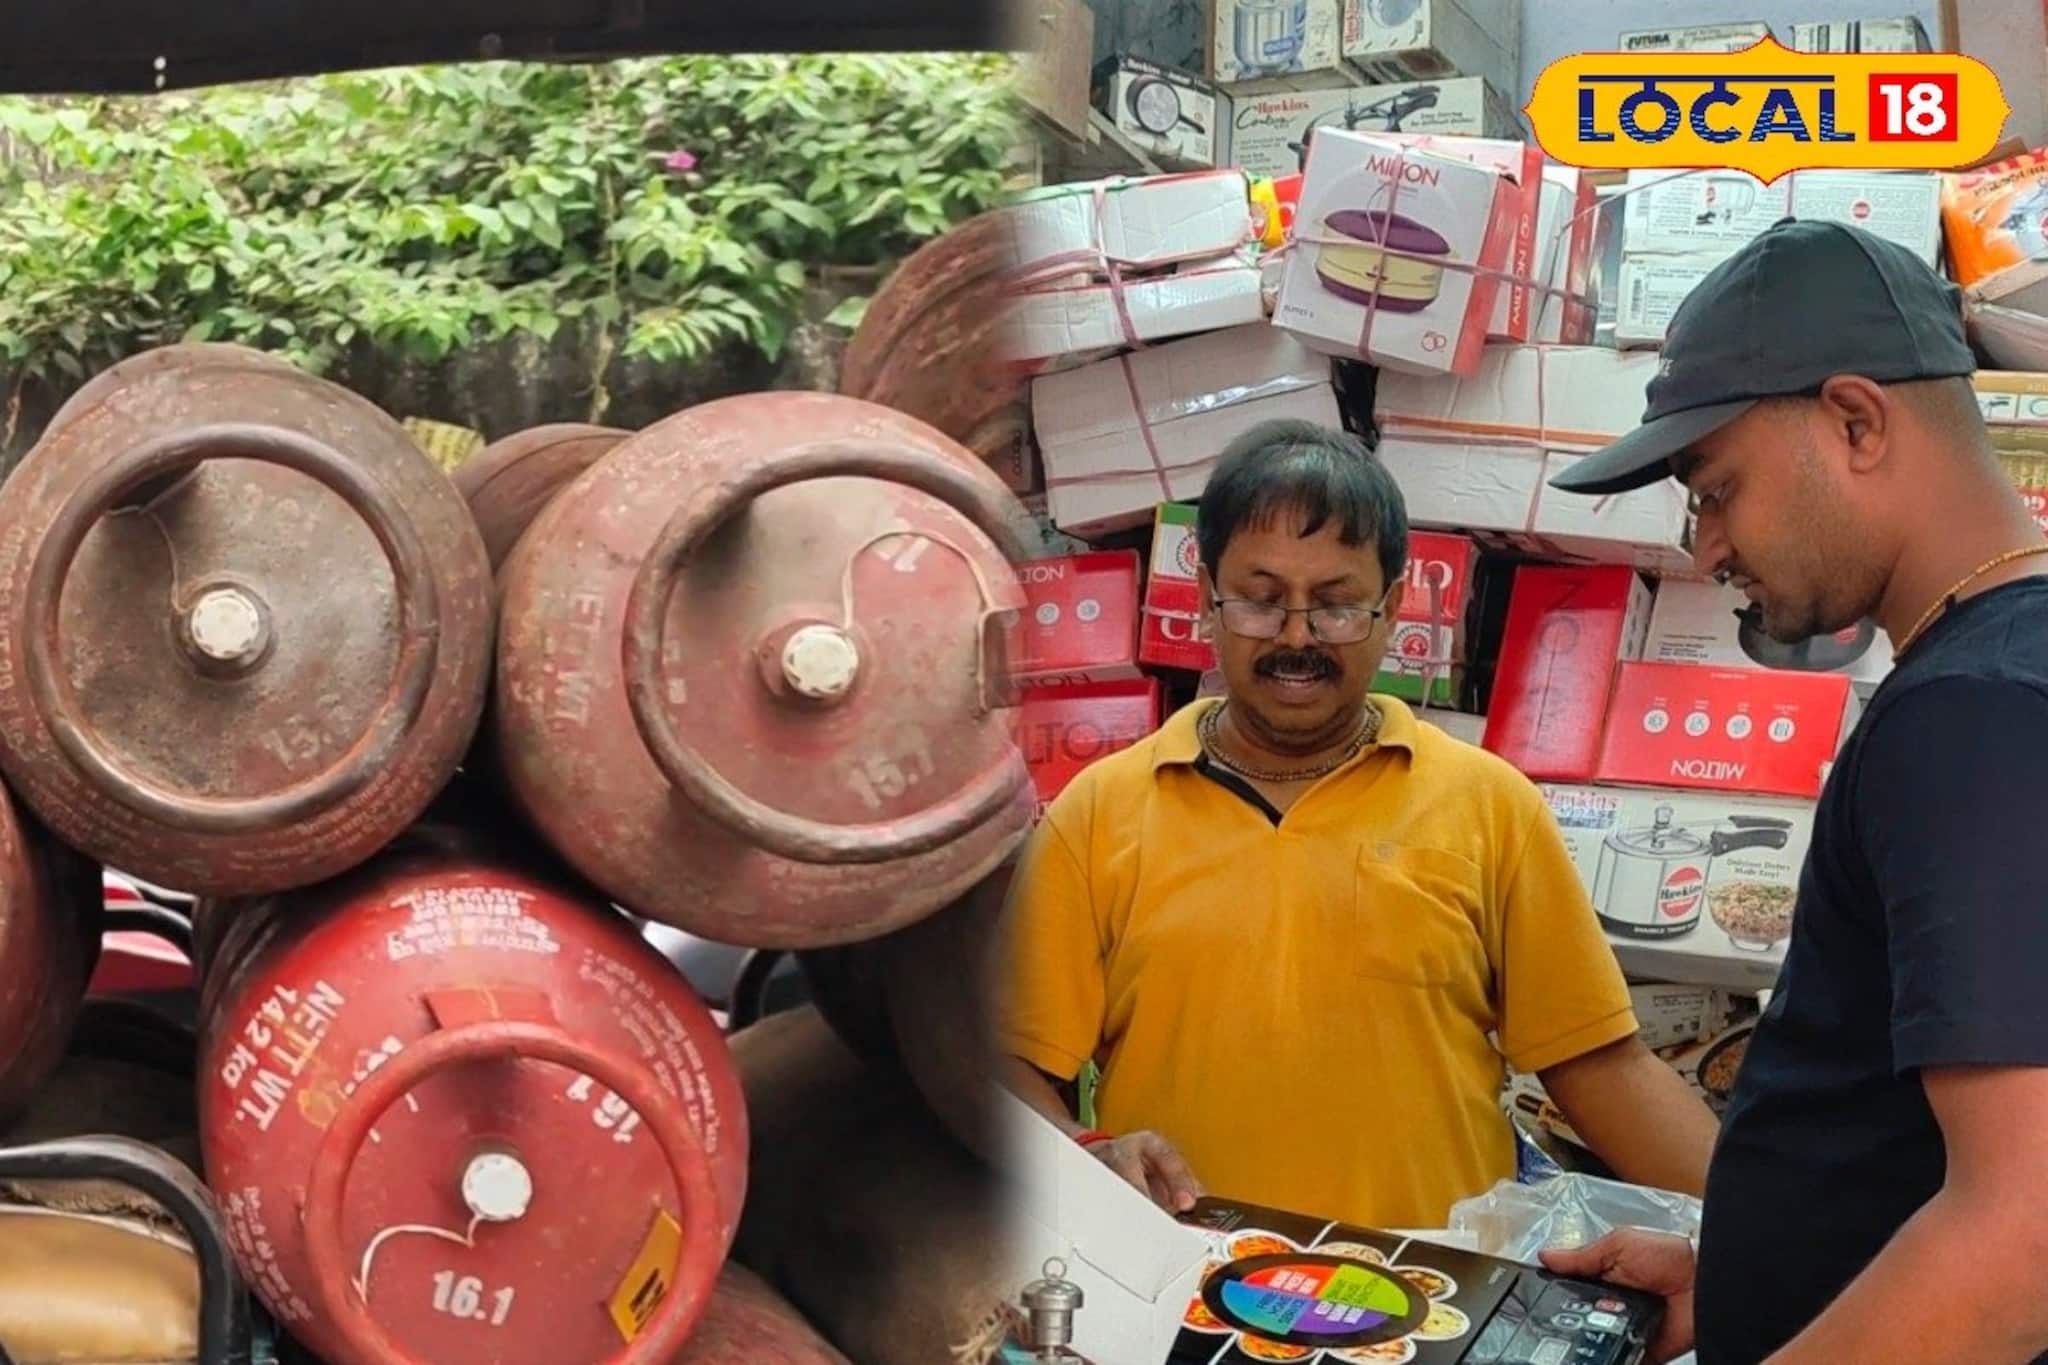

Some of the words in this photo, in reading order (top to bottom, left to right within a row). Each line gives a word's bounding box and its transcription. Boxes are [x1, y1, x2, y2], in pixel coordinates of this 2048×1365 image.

[1627, 33, 1670, 50] FUTURA
[1257, 98, 1310, 113] Hawkins
[1365, 153, 1441, 188] MILTON
[1670, 758, 1746, 781] MILTON
[234, 1067, 295, 1132] WT.
[432, 1269, 515, 1326] 16.1
